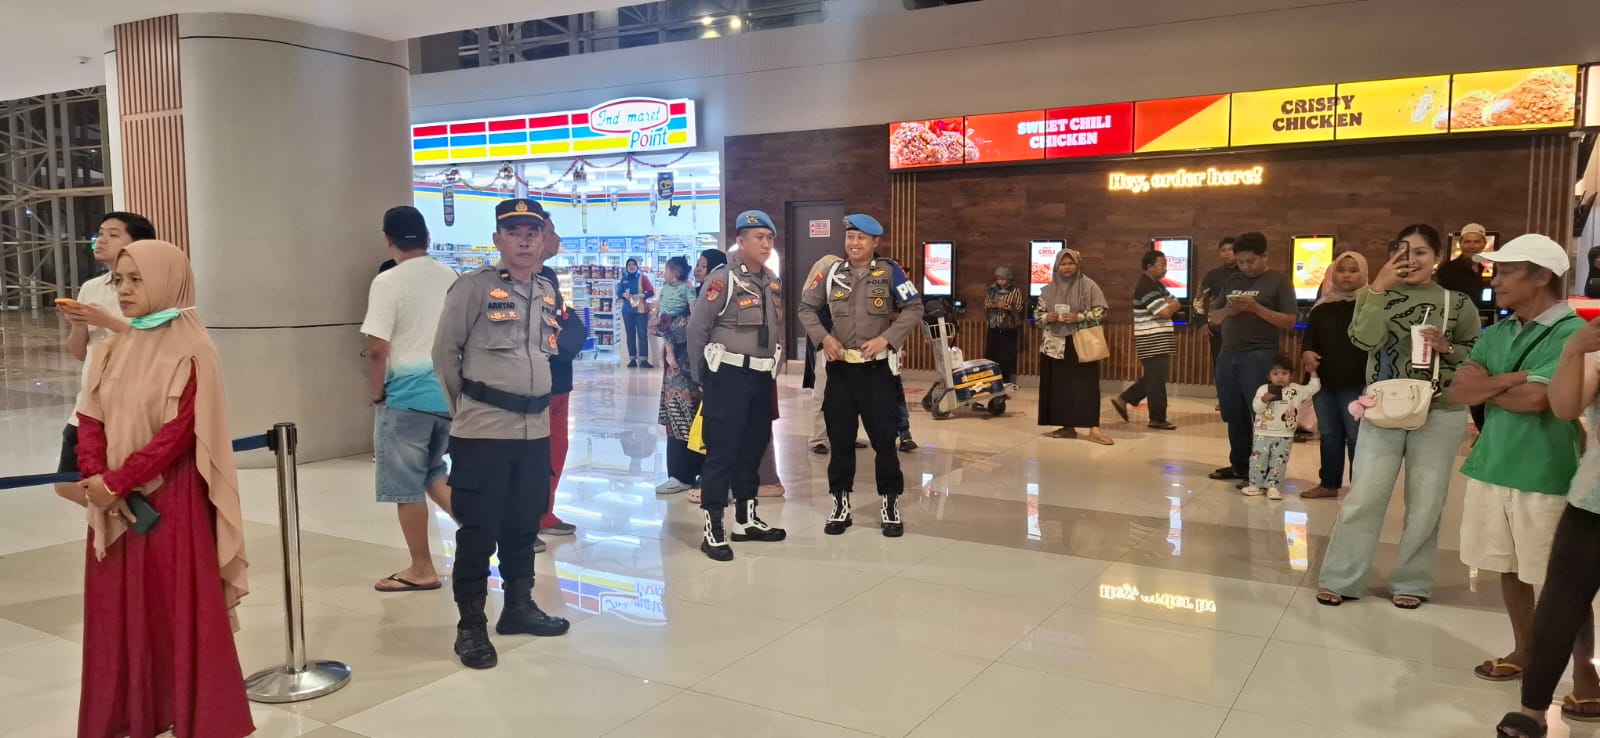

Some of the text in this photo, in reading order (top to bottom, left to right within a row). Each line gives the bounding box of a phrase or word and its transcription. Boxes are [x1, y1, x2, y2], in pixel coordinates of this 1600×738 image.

[1281, 95, 1355, 115] CRISPY
[1017, 115, 1112, 135] SWEET CHILI
[1272, 112, 1363, 132] CHICKEN
[630, 127, 667, 148] Point
[1029, 132, 1098, 149] CHICKEN
[1108, 165, 1264, 193] Hey, order here!
